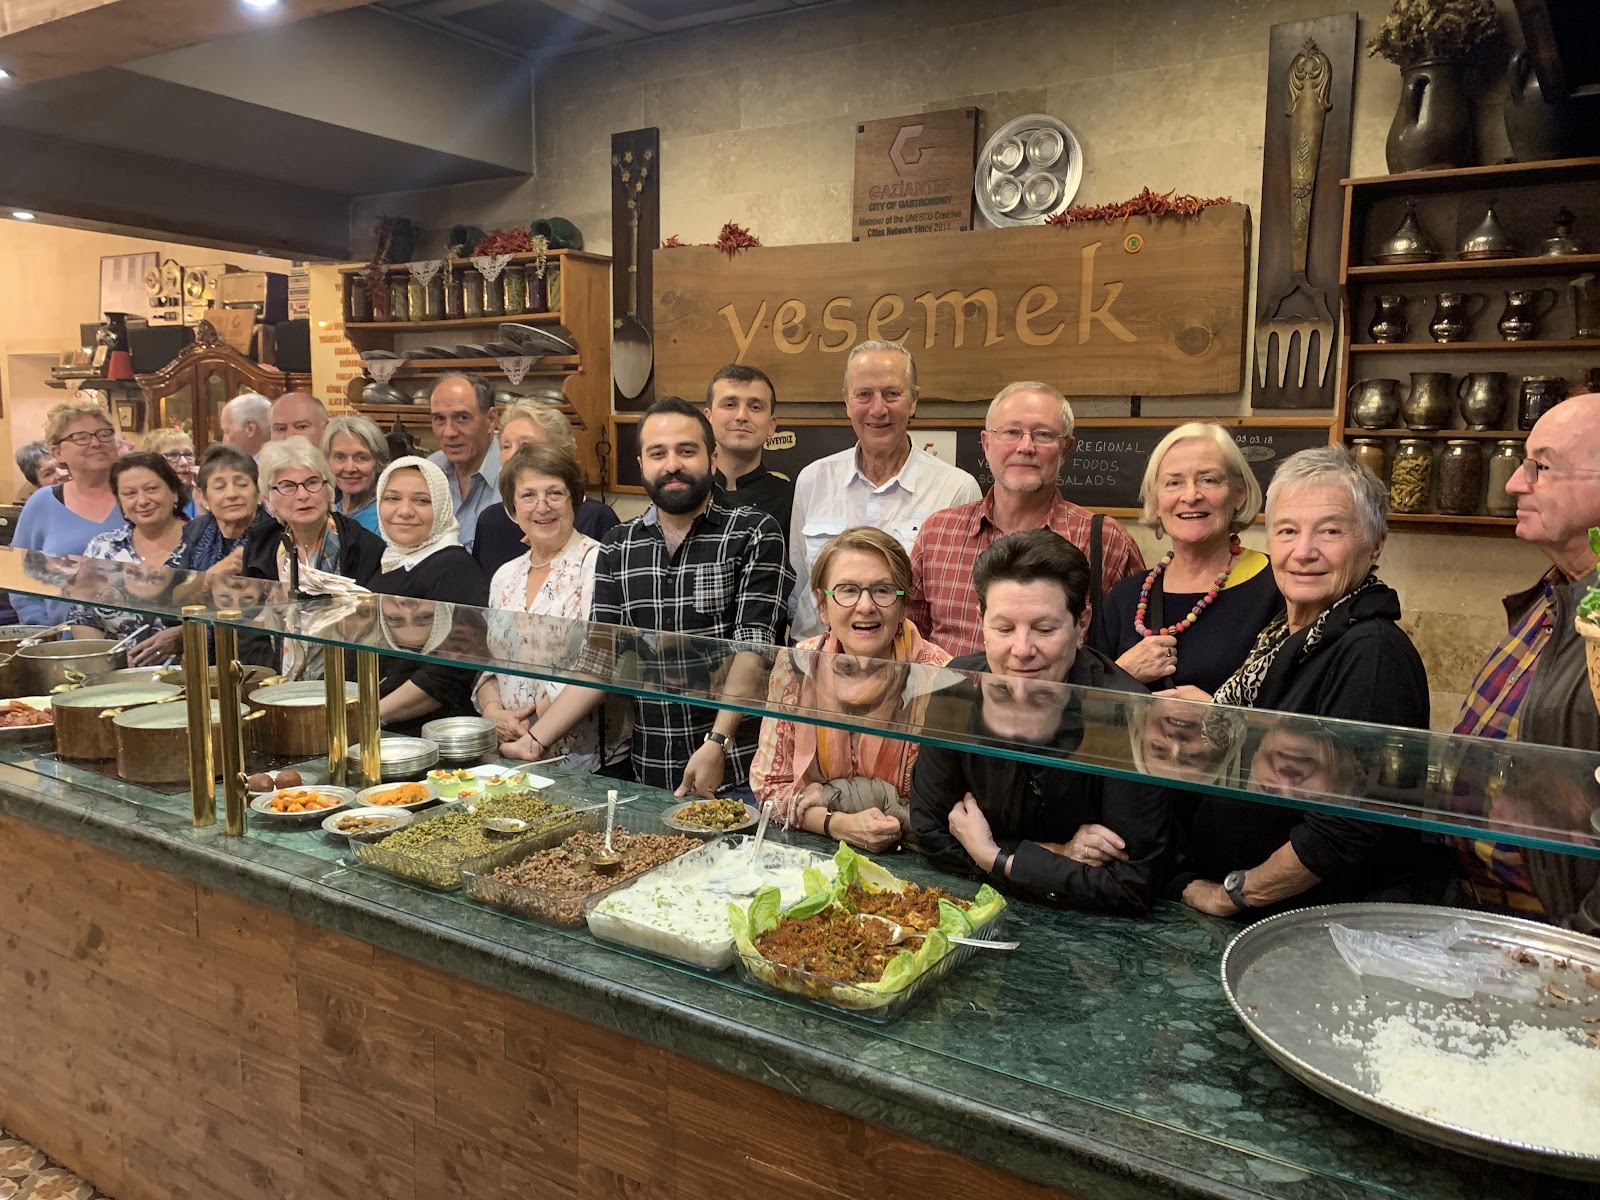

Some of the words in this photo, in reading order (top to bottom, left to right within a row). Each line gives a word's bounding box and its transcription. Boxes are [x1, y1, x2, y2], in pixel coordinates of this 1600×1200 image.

[868, 201, 886, 212] CITY
[886, 200, 898, 210] OF
[898, 195, 953, 209] GASTRONOMY
[858, 217, 884, 227] Member
[886, 215, 893, 225] of
[893, 215, 904, 224] the
[905, 212, 933, 222] UNESCO
[934, 210, 962, 220] Creative
[867, 228, 885, 238] Cities
[886, 226, 912, 236] Network
[914, 224, 933, 233] Since
[933, 222, 951, 232] 2015
[717, 240, 1138, 365] yesemek
[1075, 439, 1147, 453] REGIONAL
[1072, 458, 1119, 472] FOODS
[1055, 475, 1117, 486] SALADS
